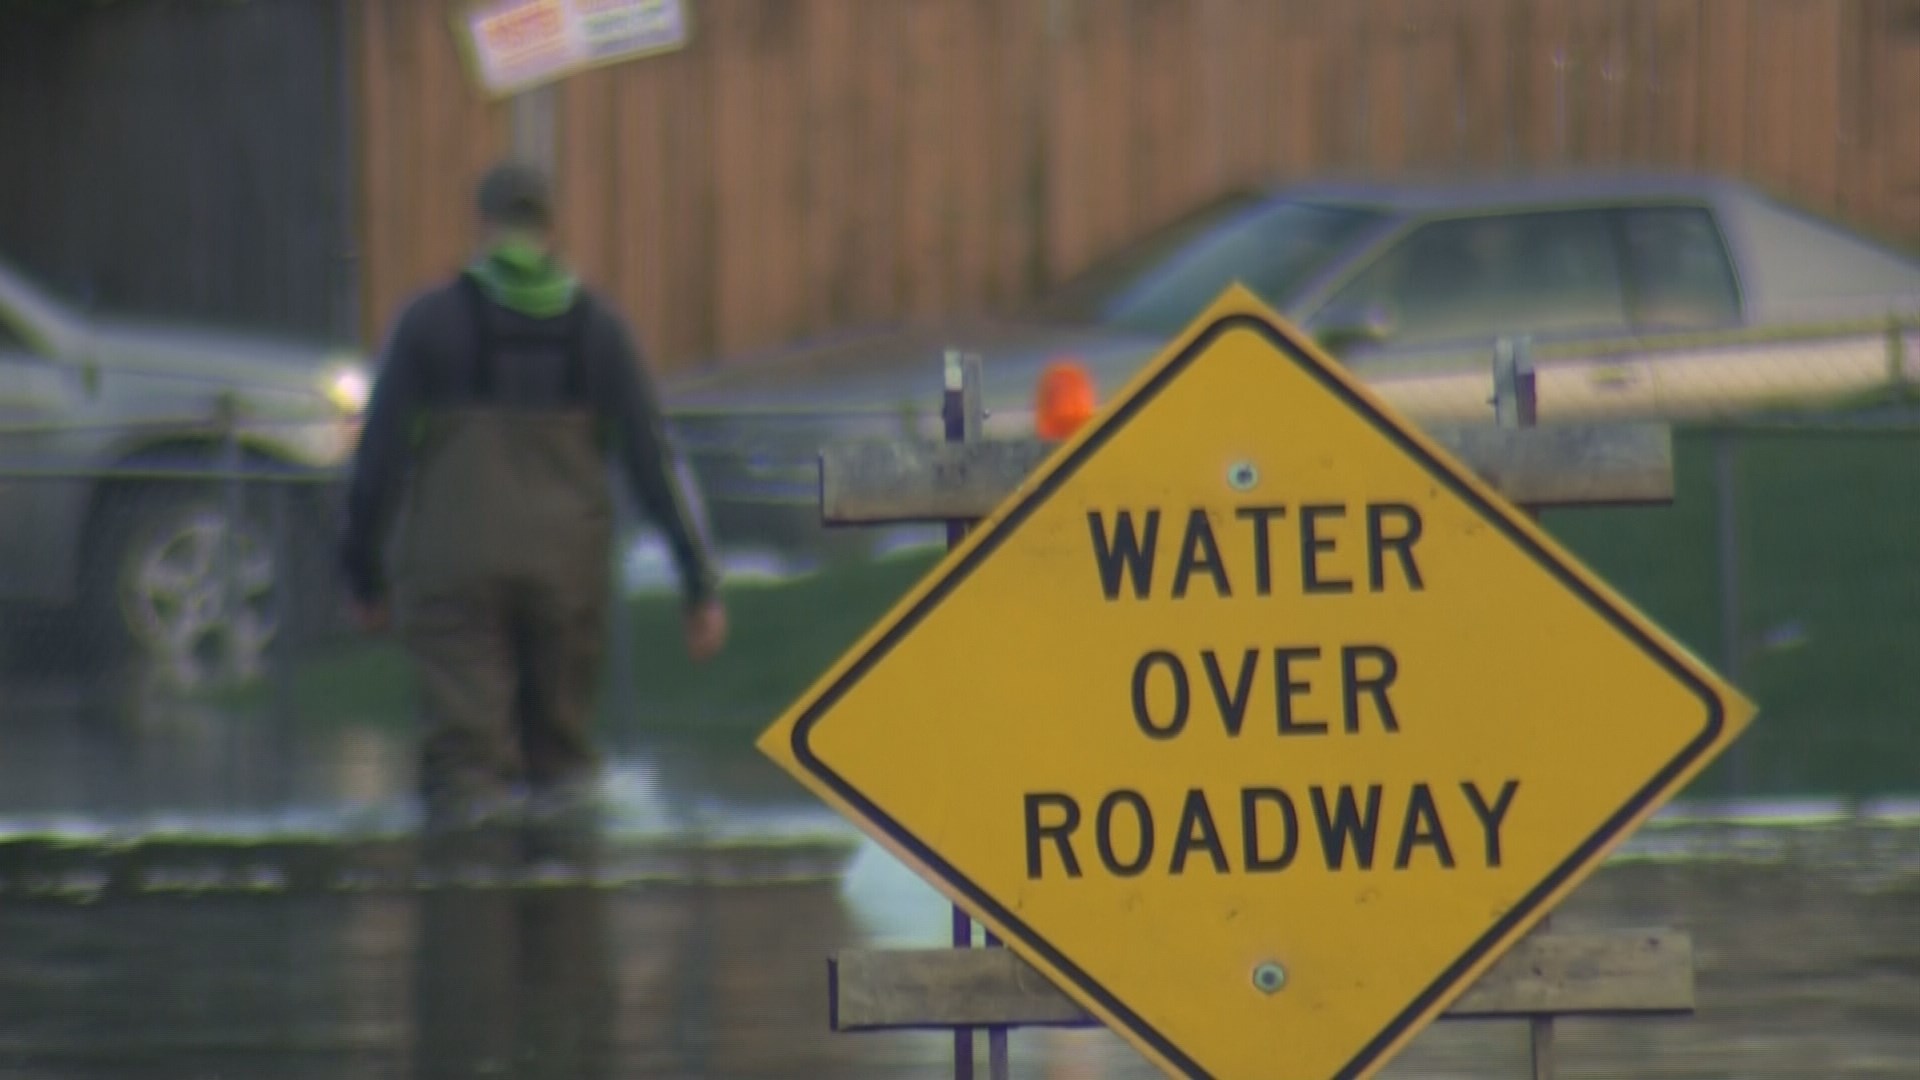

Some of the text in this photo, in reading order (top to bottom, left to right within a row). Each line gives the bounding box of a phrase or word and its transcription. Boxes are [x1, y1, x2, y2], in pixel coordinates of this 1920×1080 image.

[1087, 502, 1425, 600] WATER
[1130, 644, 1400, 740] OVER
[1023, 779, 1521, 880] ROADWAY
